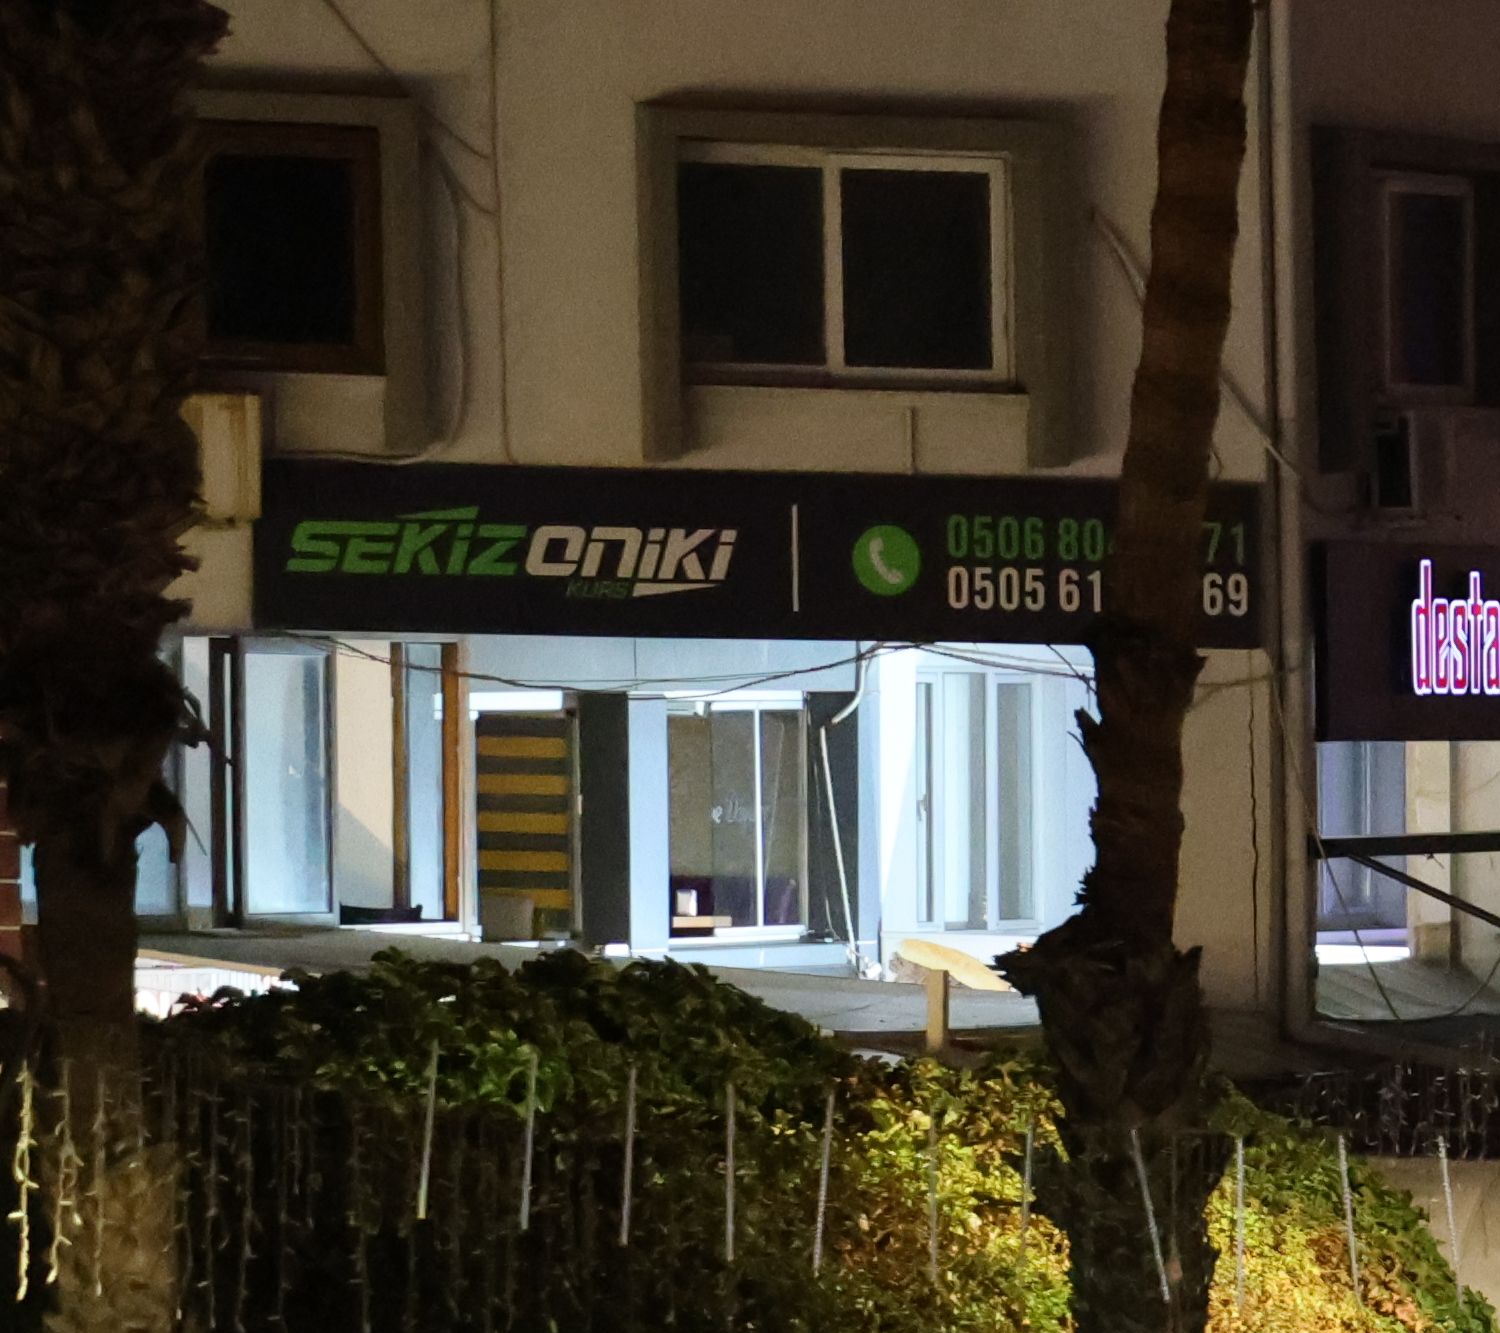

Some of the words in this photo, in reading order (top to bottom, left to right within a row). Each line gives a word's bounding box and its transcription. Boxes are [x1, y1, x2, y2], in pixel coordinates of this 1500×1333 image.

[948, 515, 1045, 560] 0506
[1057, 518, 1105, 561] 80
[948, 565, 1046, 611] 0505
[1058, 568, 1102, 613] 61
